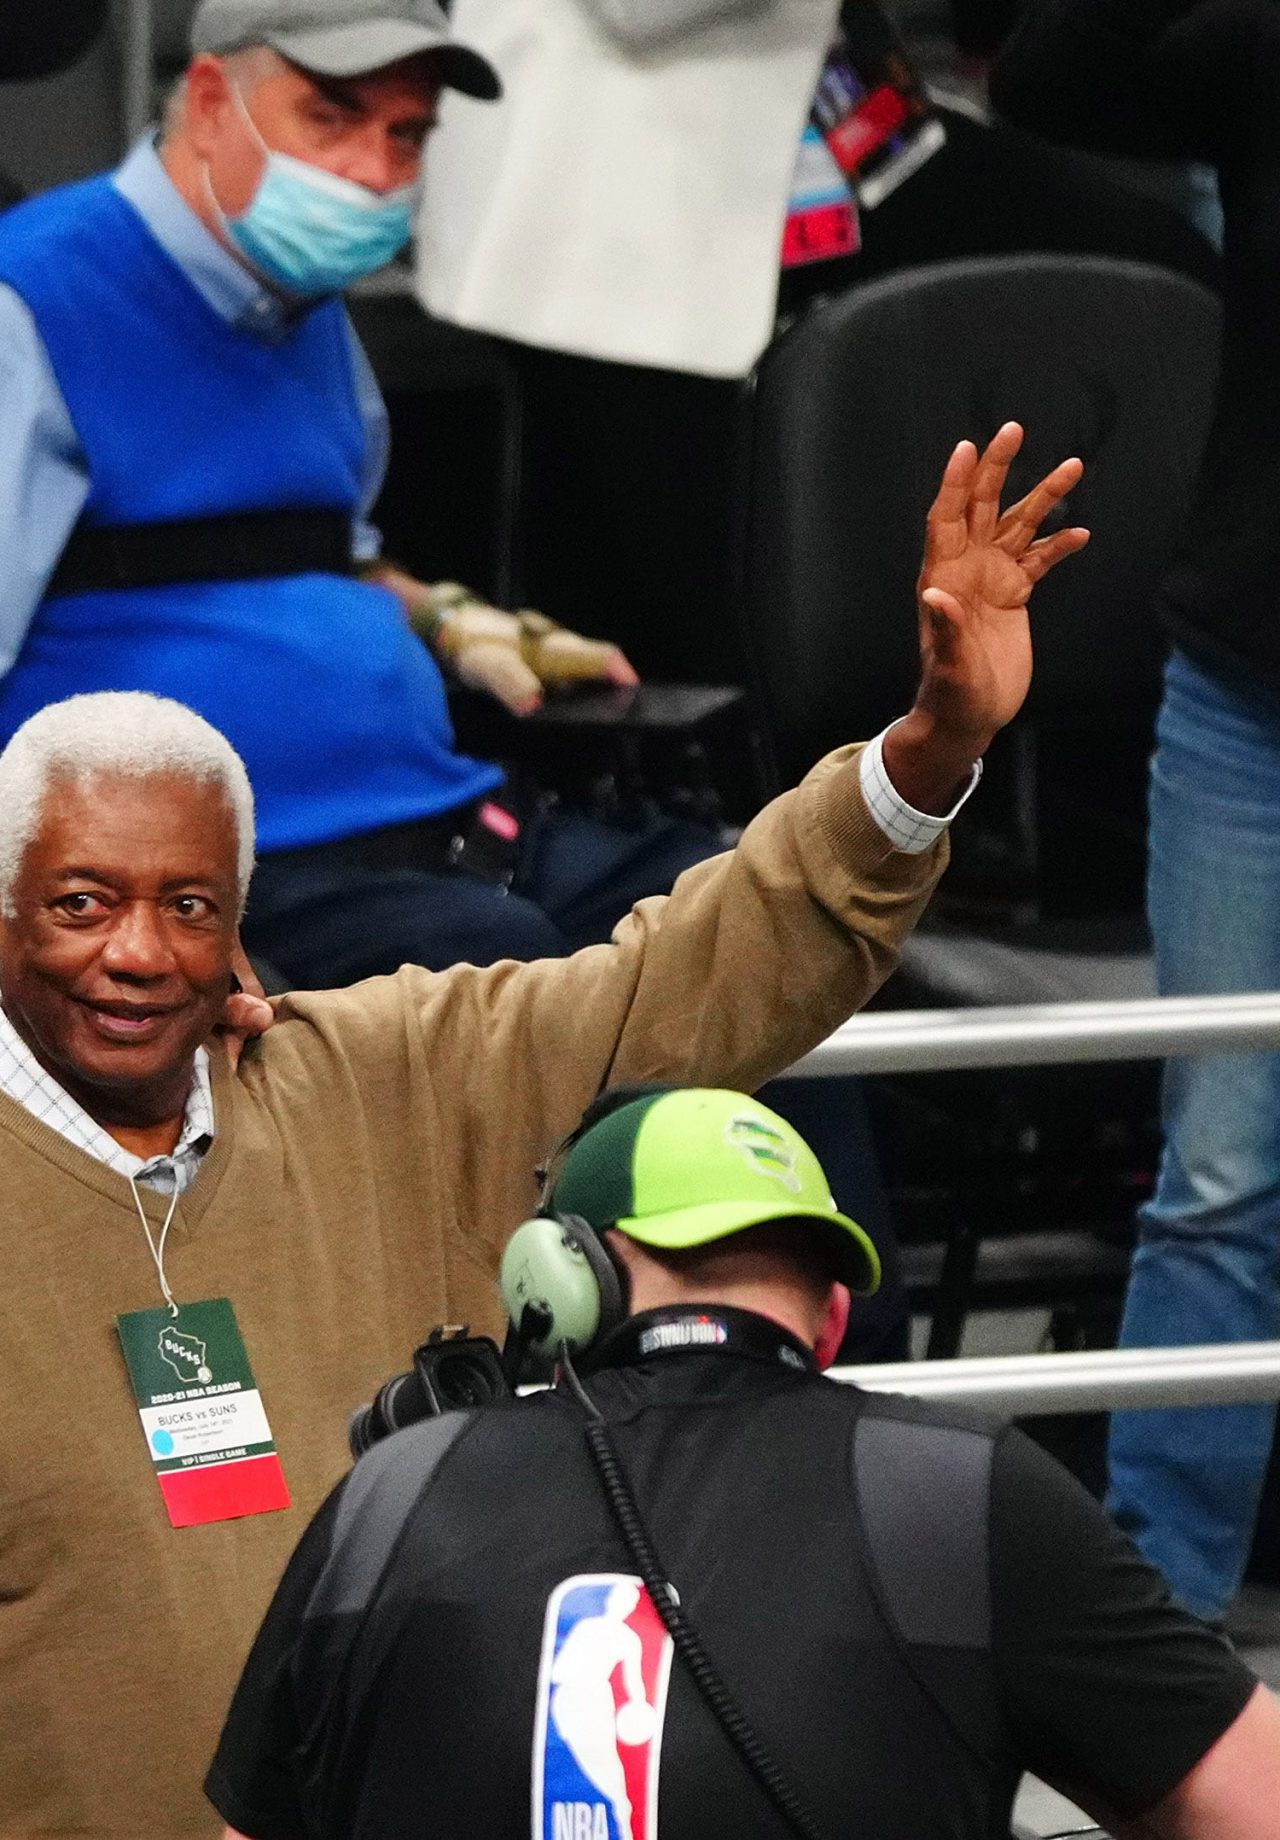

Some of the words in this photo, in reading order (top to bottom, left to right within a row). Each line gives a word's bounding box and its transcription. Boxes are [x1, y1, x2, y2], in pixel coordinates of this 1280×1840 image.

[164, 1339, 201, 1365] BUCKS
[186, 1388, 206, 1398] NBA
[206, 1382, 241, 1395] SEASON
[158, 1411, 193, 1426] BUCKS
[195, 1411, 207, 1420] vs
[208, 1404, 238, 1417] SUNS
[551, 1801, 609, 1840] NBA
